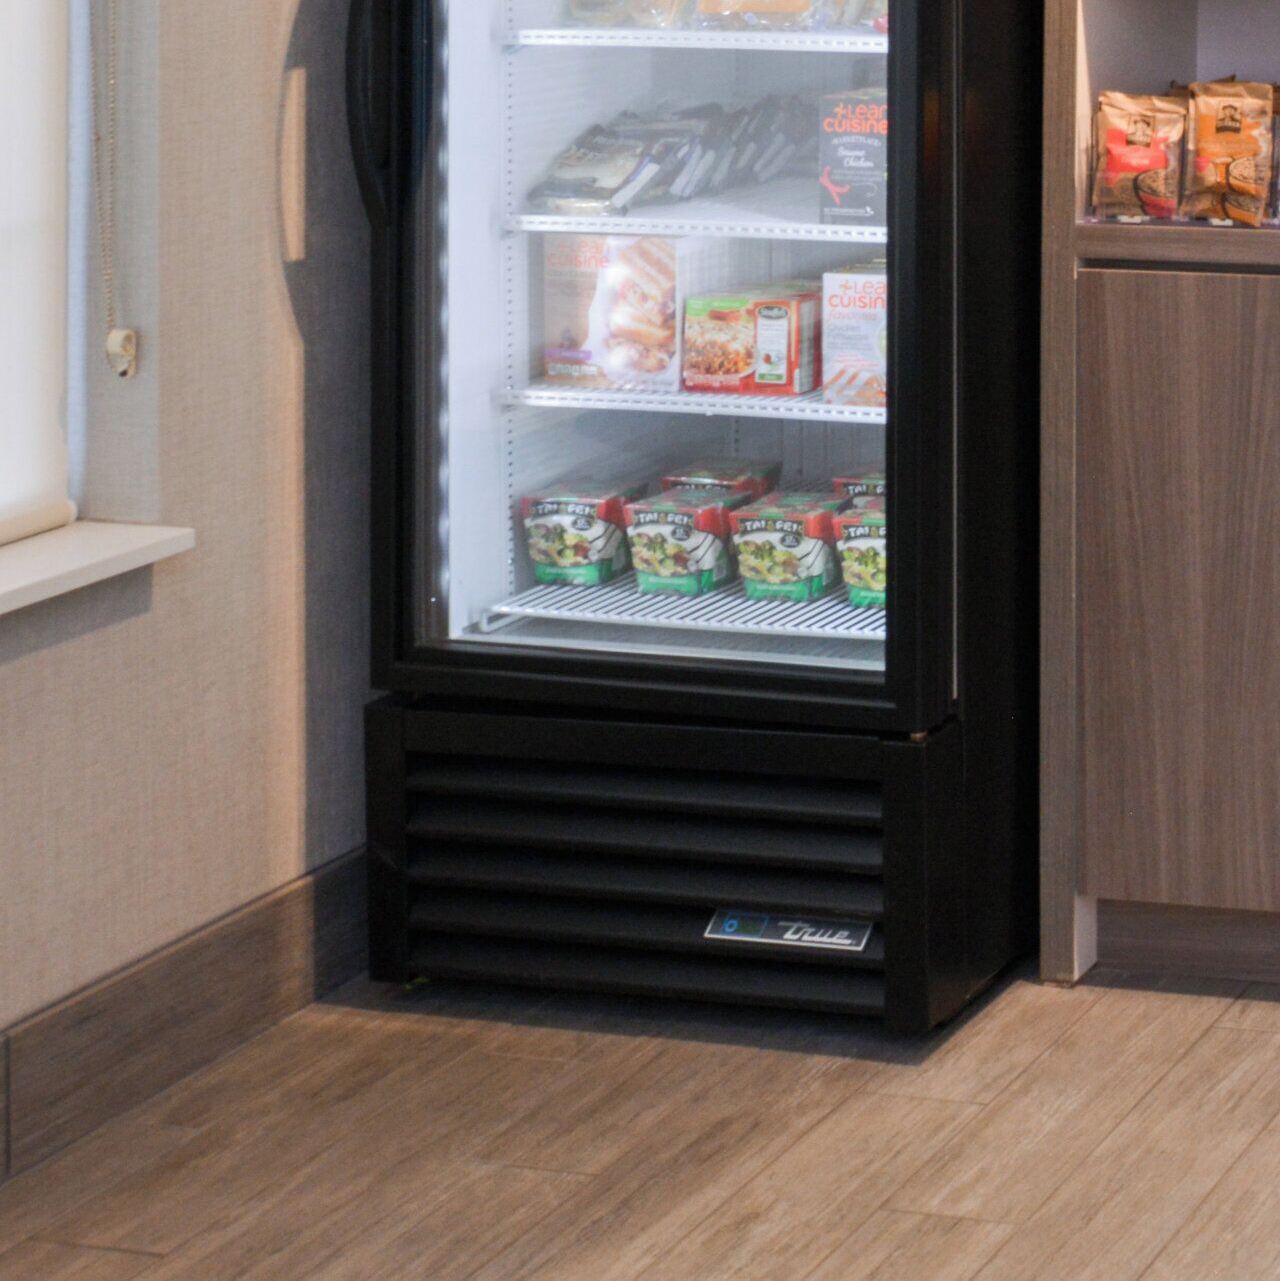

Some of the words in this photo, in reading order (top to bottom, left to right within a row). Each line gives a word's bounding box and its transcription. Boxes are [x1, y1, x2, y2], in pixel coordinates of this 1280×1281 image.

[823, 118, 888, 134] cuisine
[853, 280, 887, 294] Lea
[847, 483, 868, 495] TAI
[537, 503, 557, 515] TAI
[637, 512, 658, 524] TAI
[745, 521, 766, 532] TAI
[847, 525, 868, 537] TAI
[779, 922, 853, 945] True
